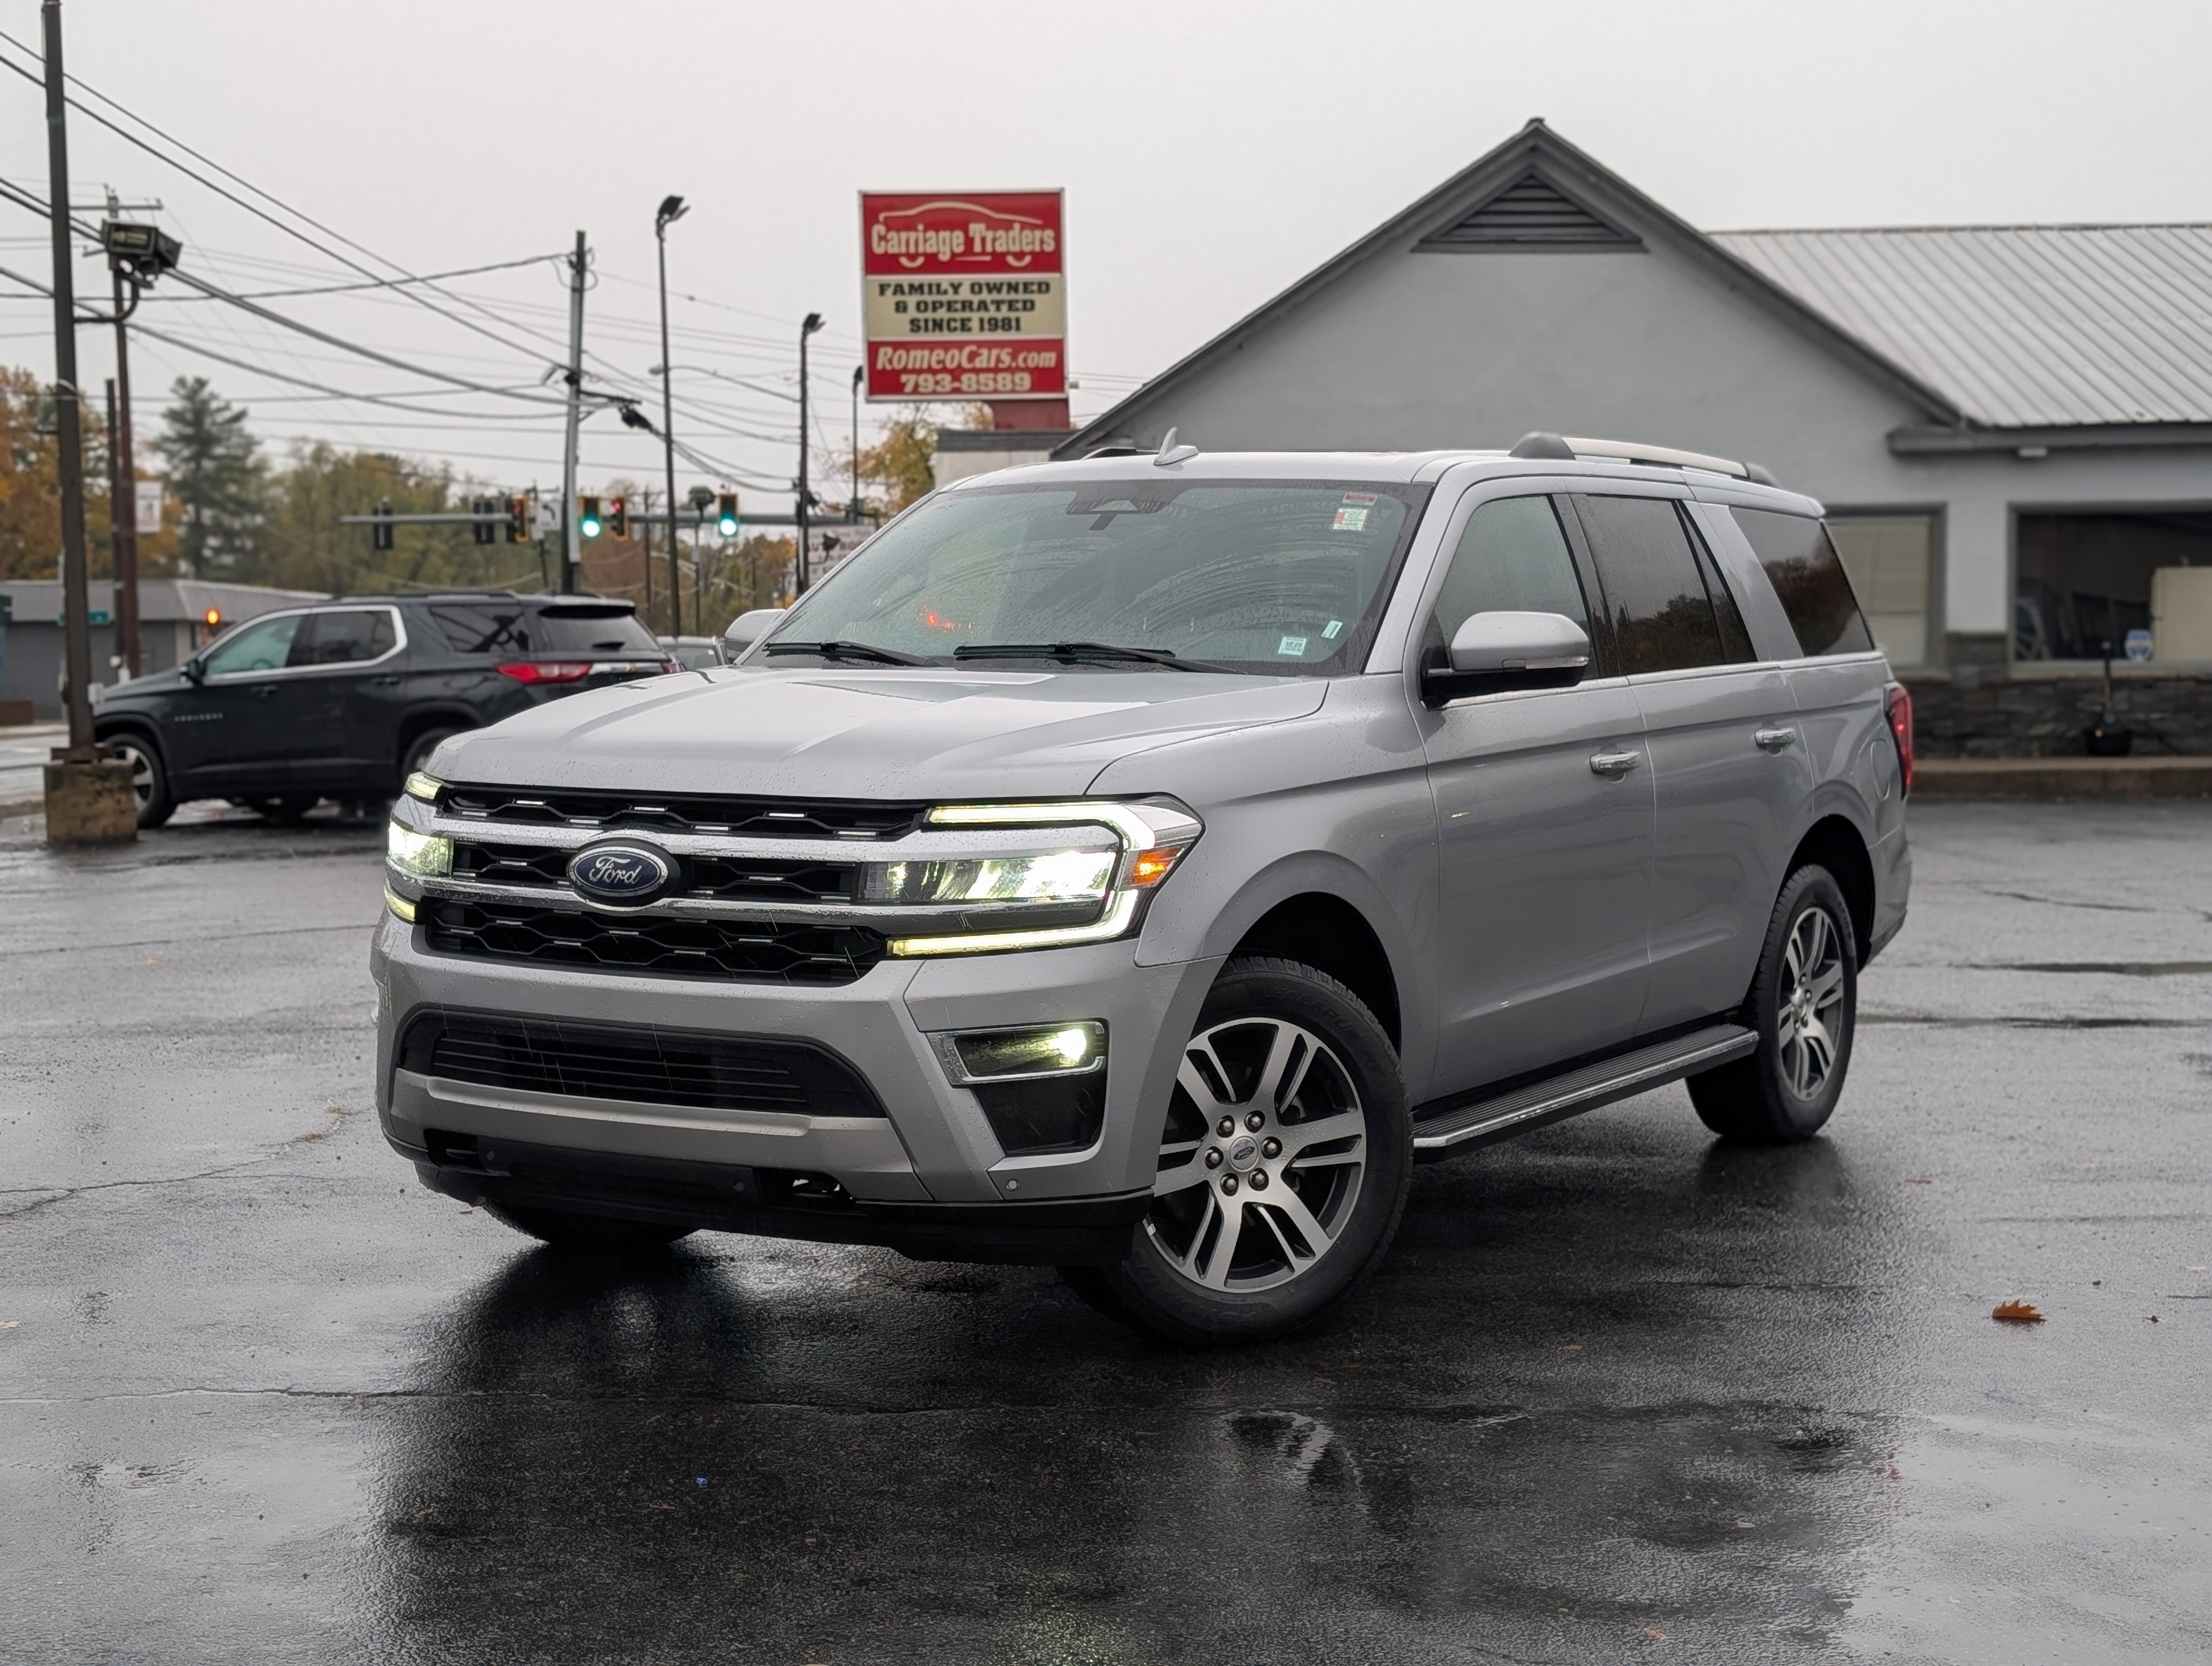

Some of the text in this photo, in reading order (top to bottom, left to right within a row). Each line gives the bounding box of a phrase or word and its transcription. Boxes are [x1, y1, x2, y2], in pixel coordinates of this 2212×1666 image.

[872, 222, 1055, 261] Carriage Traders
[878, 281, 1051, 296] FAMILY OWNED
[895, 299, 1035, 313] & OPERATED
[909, 317, 1021, 333] SINCE 1981
[876, 345, 1056, 370] RomeoCars.com
[900, 373, 1031, 393] 793-8589
[589, 856, 642, 884] Ford
